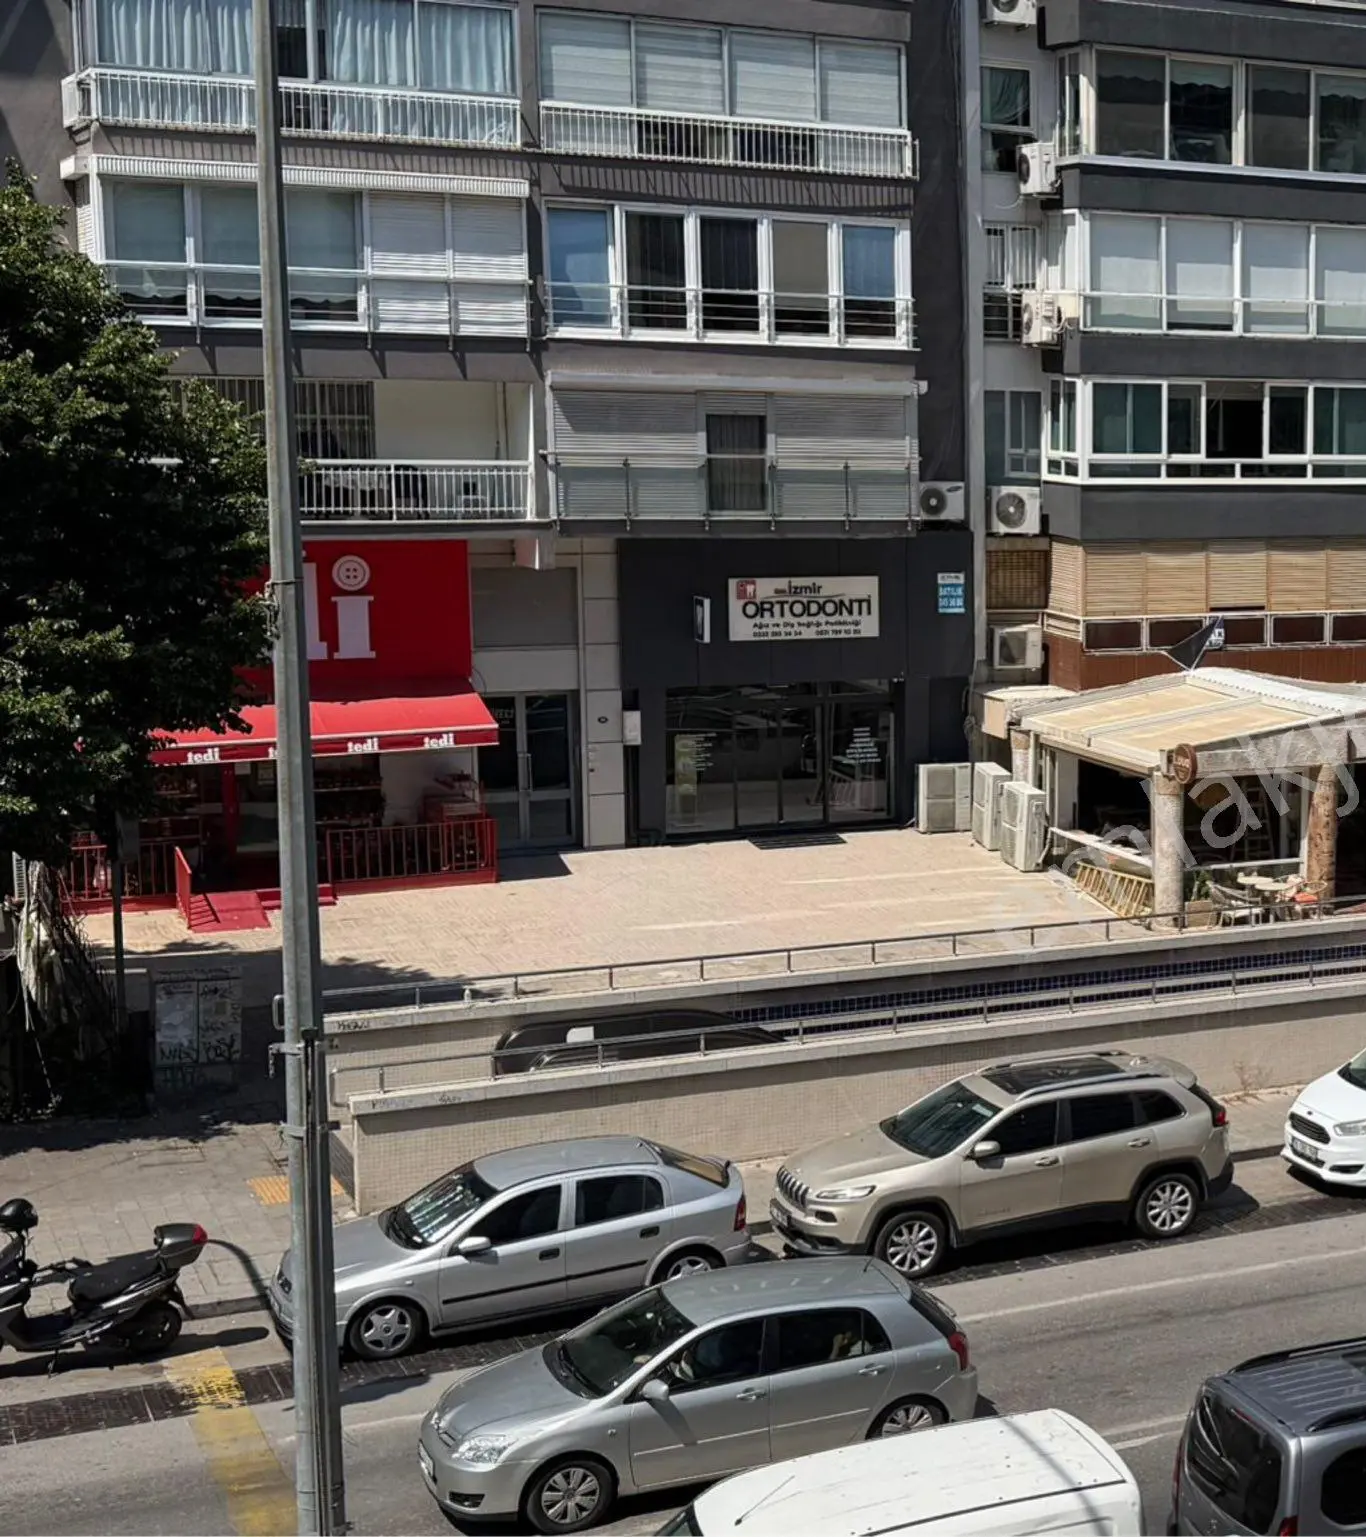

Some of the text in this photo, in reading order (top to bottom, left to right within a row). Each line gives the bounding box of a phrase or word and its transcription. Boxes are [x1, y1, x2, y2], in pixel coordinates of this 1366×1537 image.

[788, 580, 823, 595] İzmir
[742, 594, 872, 619] ORTODONTİ
[347, 737, 379, 753] tedi
[423, 733, 455, 749] tedi
[186, 747, 220, 763] tedi
